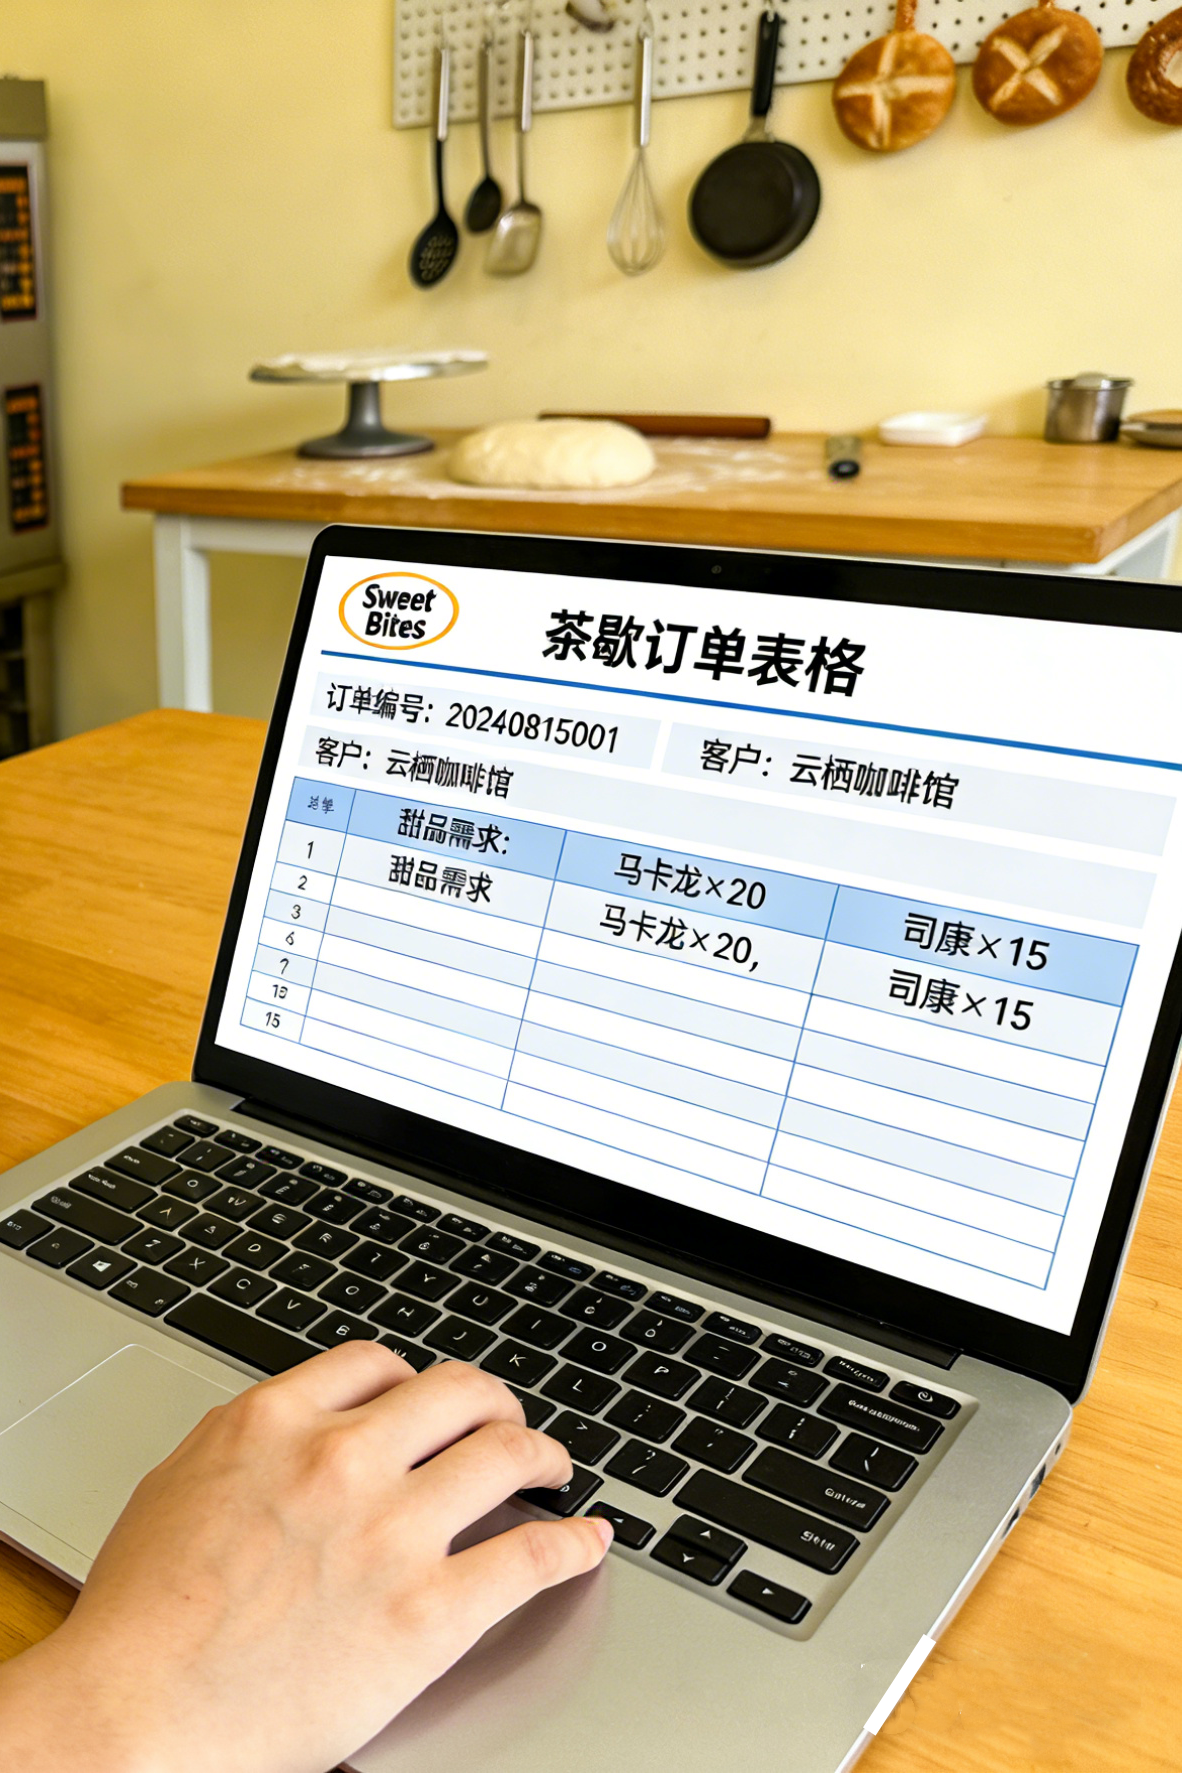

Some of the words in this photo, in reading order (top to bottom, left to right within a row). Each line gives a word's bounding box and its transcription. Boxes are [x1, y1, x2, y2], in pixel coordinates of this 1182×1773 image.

[362, 583, 437, 613] Sweet
[364, 610, 427, 640] Bites
[541, 608, 867, 698] 茶歇订单表格
[306, 841, 315, 860] 1
[297, 874, 309, 891] 2
[613, 852, 767, 910] 马卡龙×20
[290, 904, 302, 920] 3
[903, 911, 1051, 971] 司康×15
[279, 957, 290, 975] 7
[888, 968, 1035, 1031] 司康×15
[265, 1011, 281, 1029] 15
